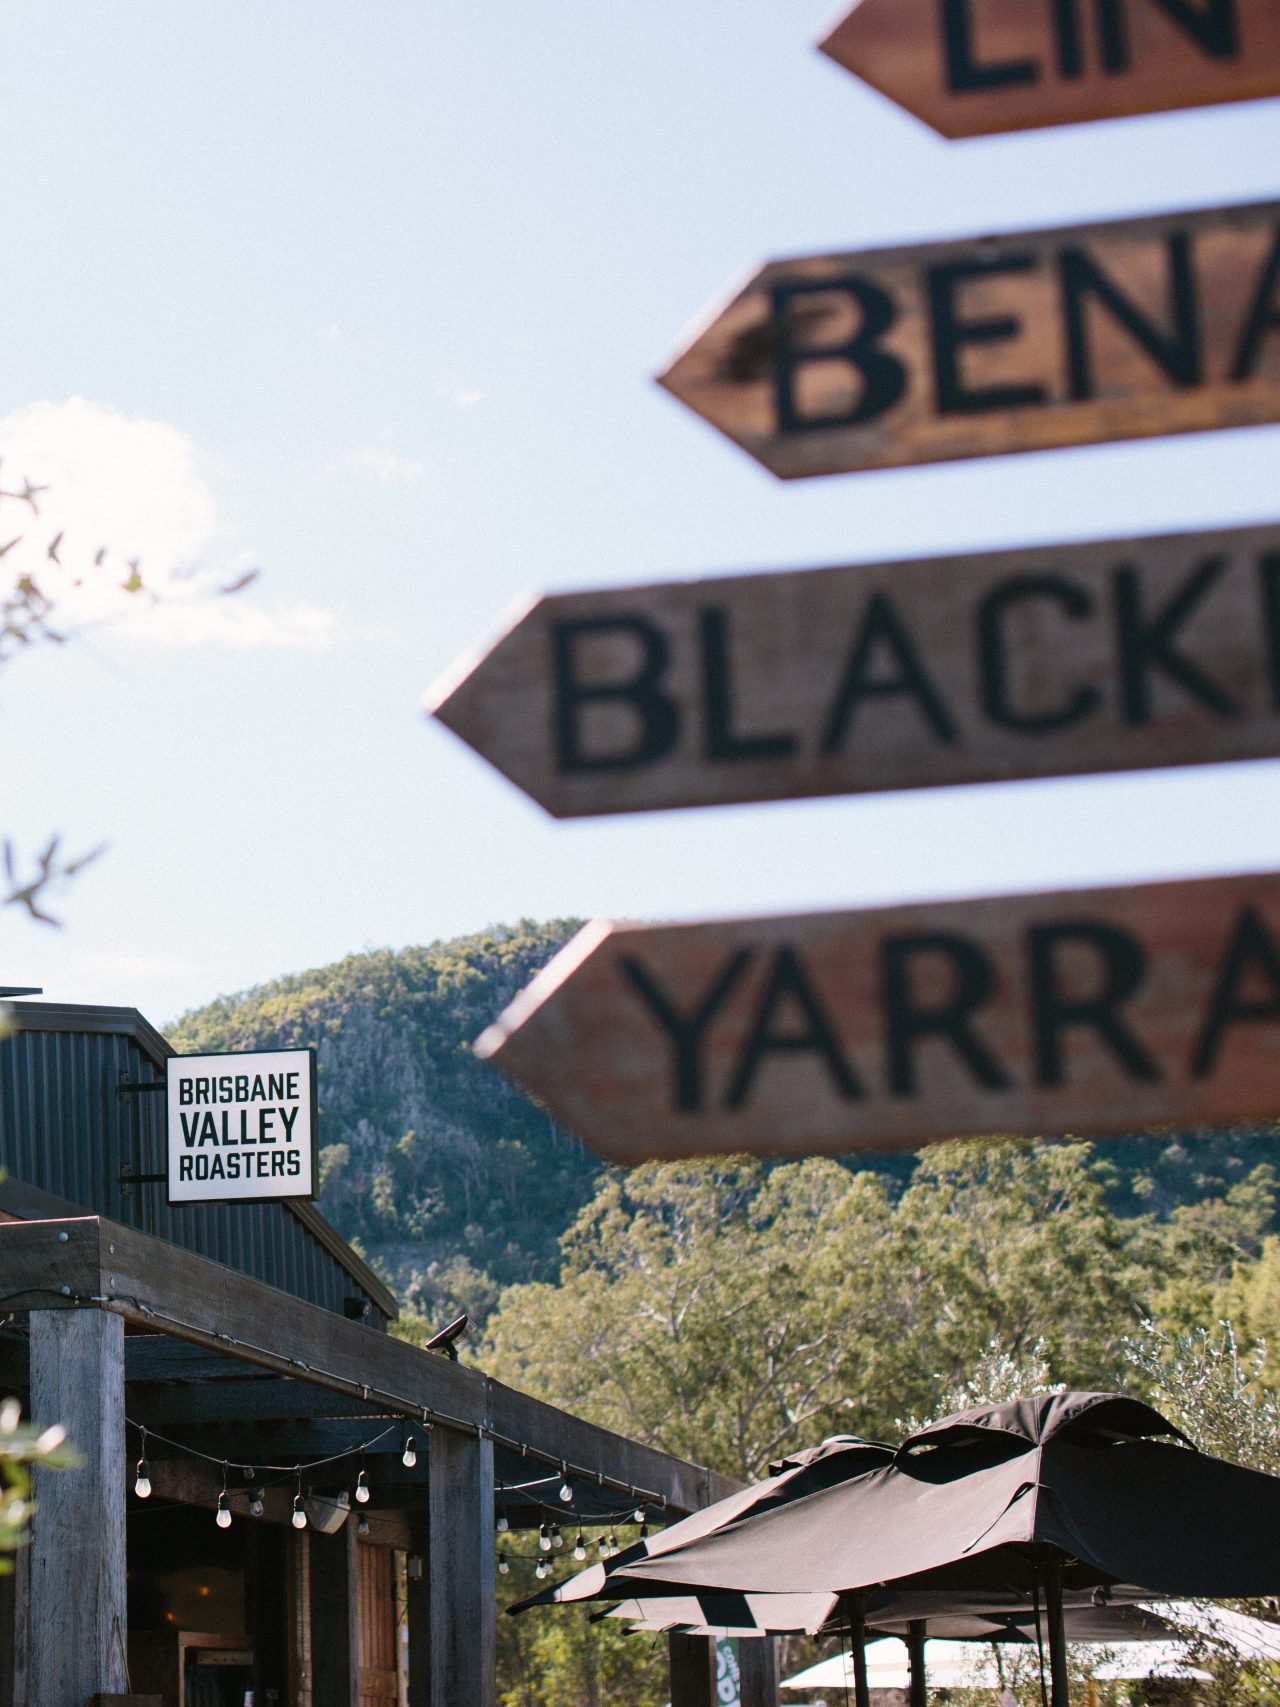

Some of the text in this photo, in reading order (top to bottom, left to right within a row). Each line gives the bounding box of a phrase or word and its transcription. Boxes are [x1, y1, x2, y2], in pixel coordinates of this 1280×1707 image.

[551, 551, 1280, 774] BLACK
[179, 1072, 300, 1106] BRISBANE
[179, 1106, 299, 1148] VALLEY
[179, 1150, 301, 1182] ROASTERS
